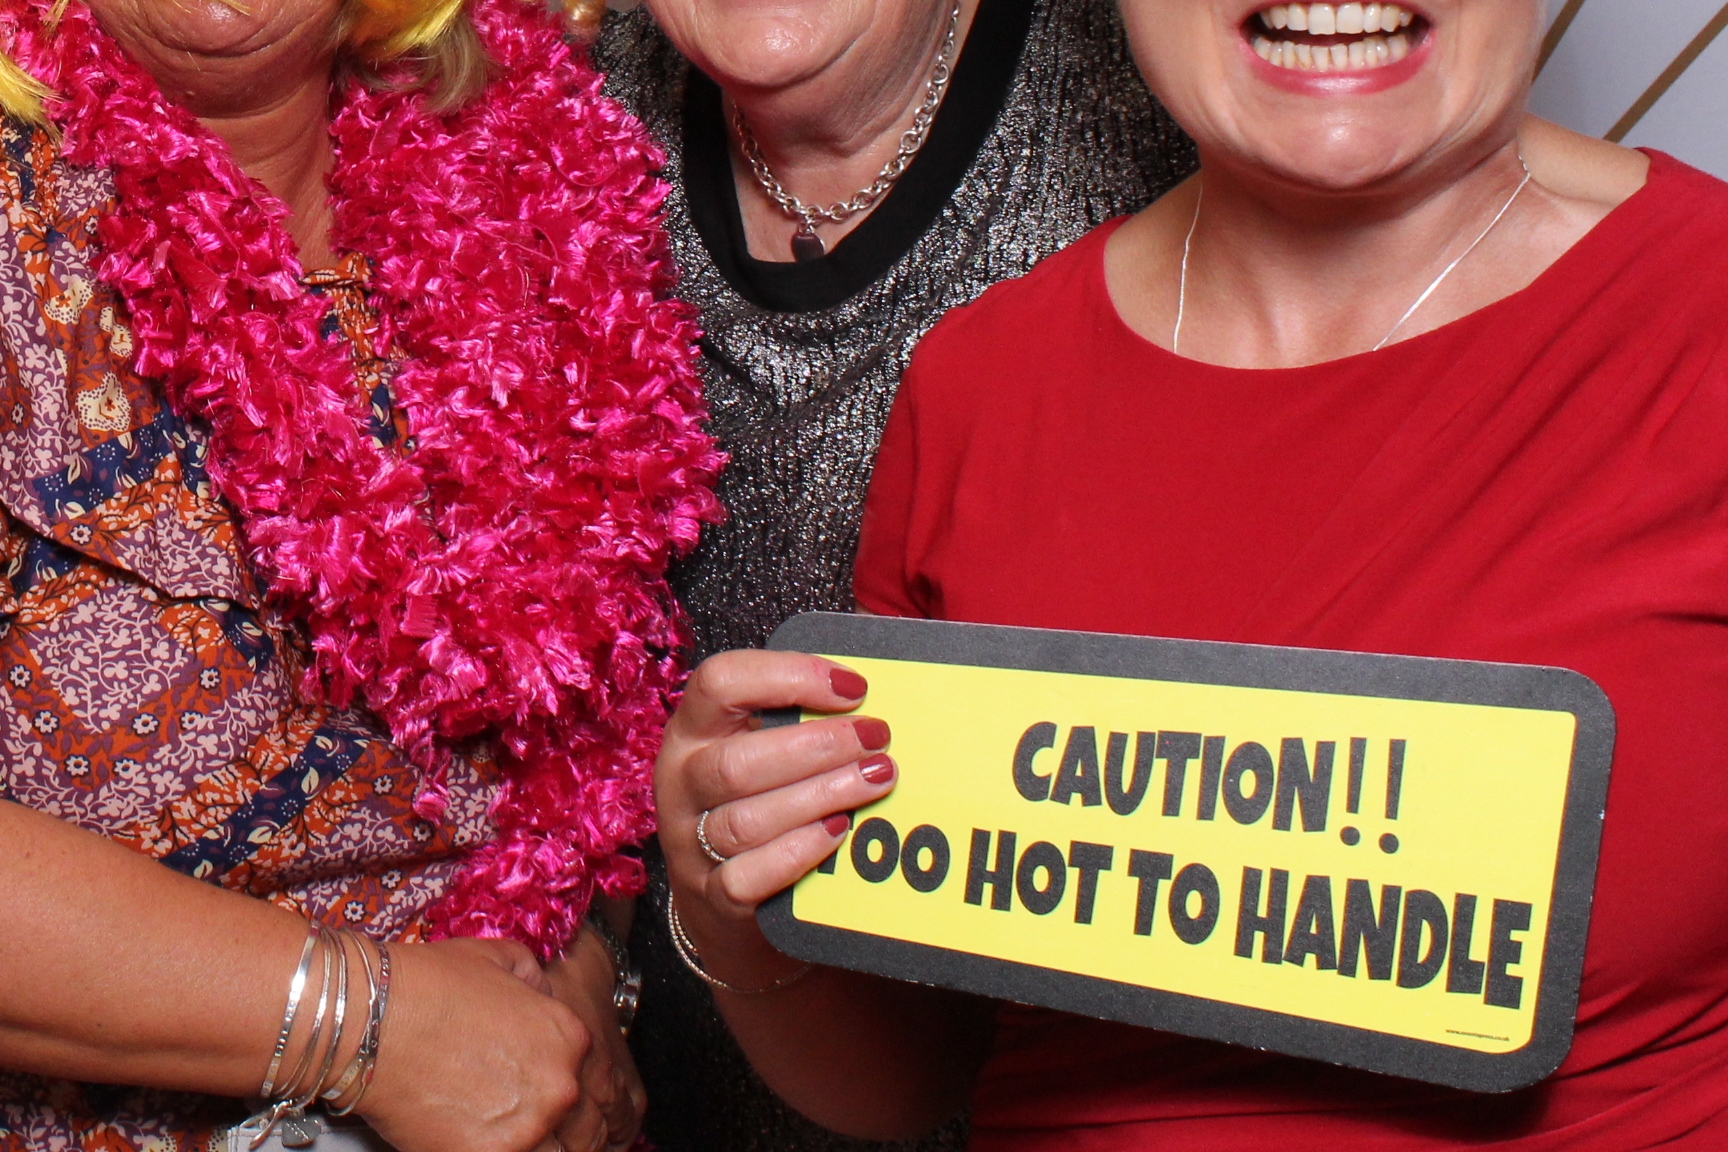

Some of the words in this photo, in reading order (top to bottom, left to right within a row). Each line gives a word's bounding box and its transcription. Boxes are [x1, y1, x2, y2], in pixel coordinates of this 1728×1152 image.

[1012, 721, 1407, 854] CAUTION!!
[964, 828, 1114, 925] HOT
[1128, 849, 1220, 945] TO
[1234, 869, 1532, 1010] HANDLE
